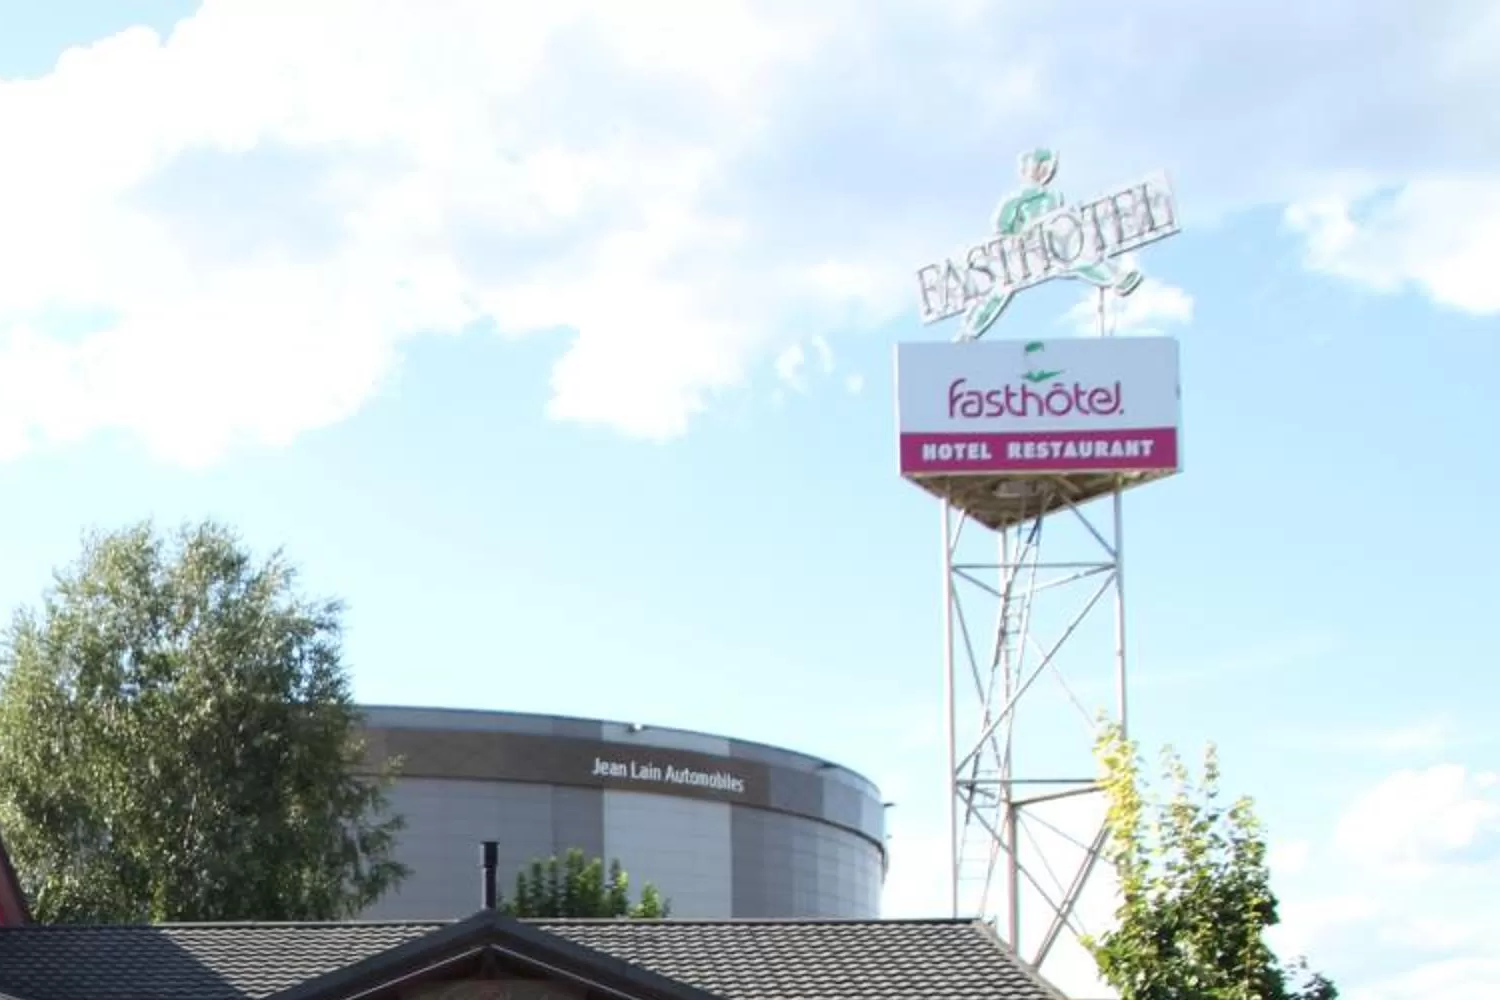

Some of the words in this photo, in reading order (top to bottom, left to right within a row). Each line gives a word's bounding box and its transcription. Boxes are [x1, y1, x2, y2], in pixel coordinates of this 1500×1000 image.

[922, 442, 991, 461] HOTEL
[1008, 439, 1154, 460] RESTAURANT
[592, 758, 627, 776] Jean
[631, 760, 661, 781] Lain
[665, 765, 745, 793] Automobiles
